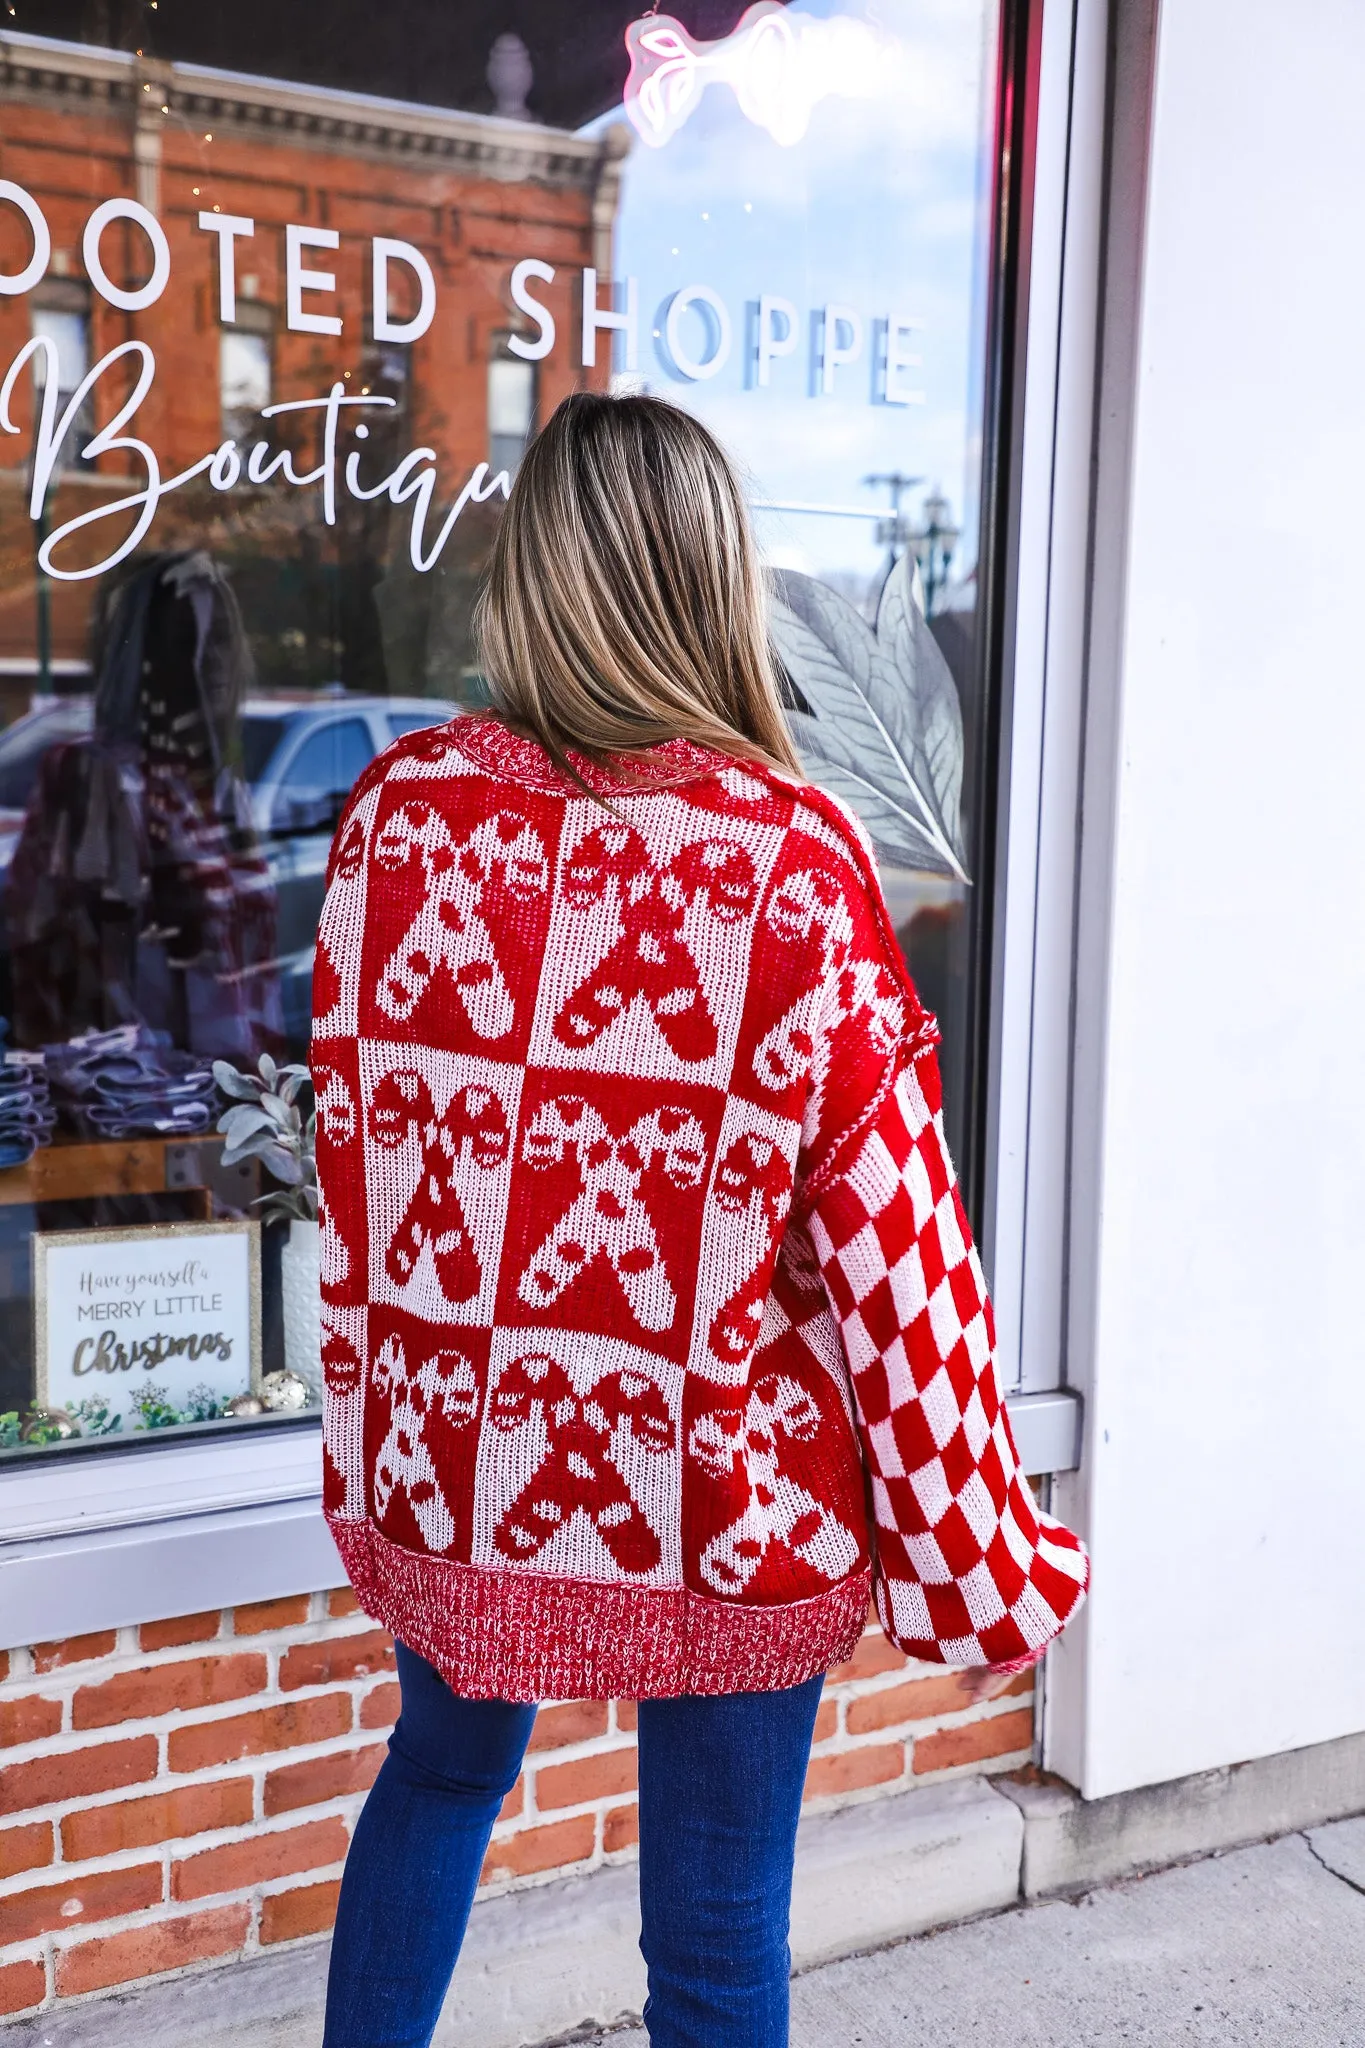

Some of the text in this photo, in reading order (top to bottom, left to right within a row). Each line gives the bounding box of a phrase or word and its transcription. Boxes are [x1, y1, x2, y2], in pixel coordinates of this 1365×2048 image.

[507, 258, 928, 404] SHOPPE
[0, 335, 511, 581] Boutiqu
[80, 1271, 119, 1295] Have
[125, 1261, 201, 1293] yourself
[78, 1293, 222, 1321] MERRY LITTLE
[72, 1330, 233, 1376] Christmas
